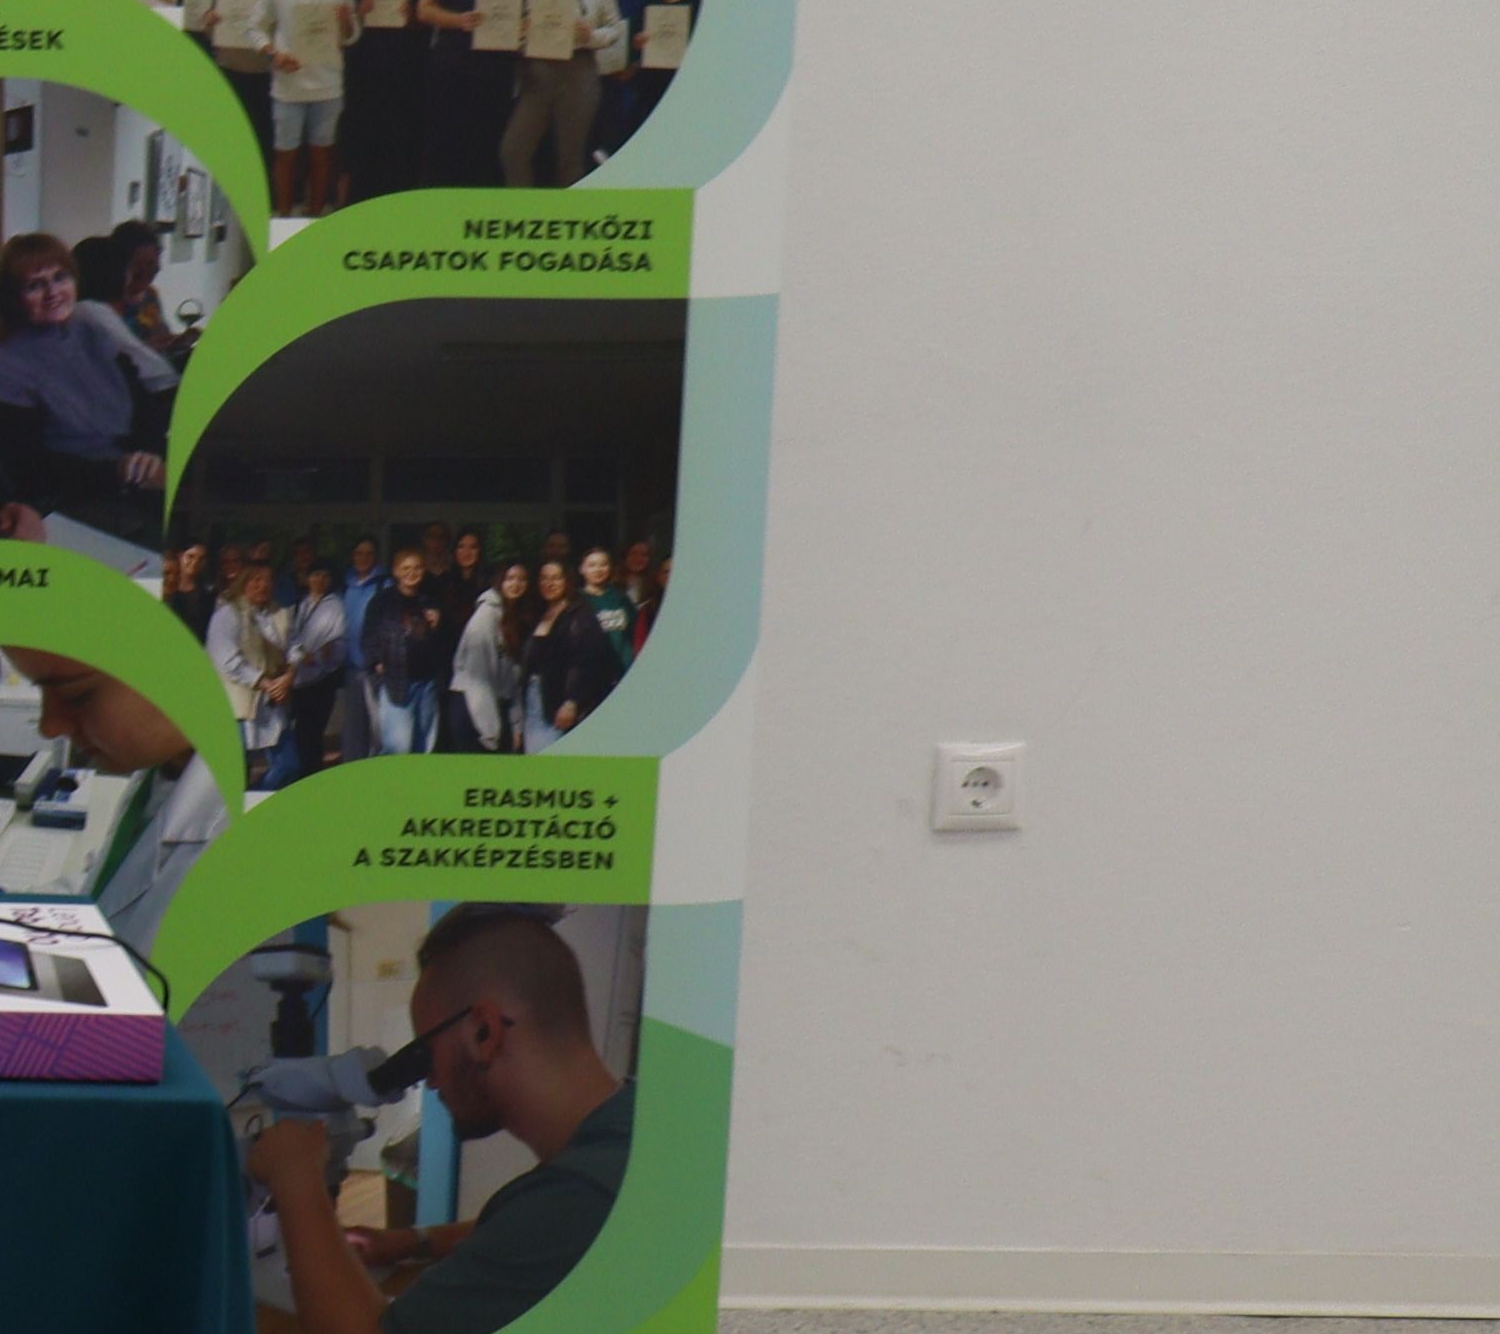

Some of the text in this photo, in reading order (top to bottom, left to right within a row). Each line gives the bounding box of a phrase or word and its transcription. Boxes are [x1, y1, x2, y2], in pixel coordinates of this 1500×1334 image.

[343, 244, 653, 273] CSAPATOK FOGADÁSA
[464, 787, 594, 810] ERASMUS
[400, 815, 617, 841] AKKREDITÁCIÓ
[352, 844, 615, 870] A SZAKKÉPZÉSBEN
